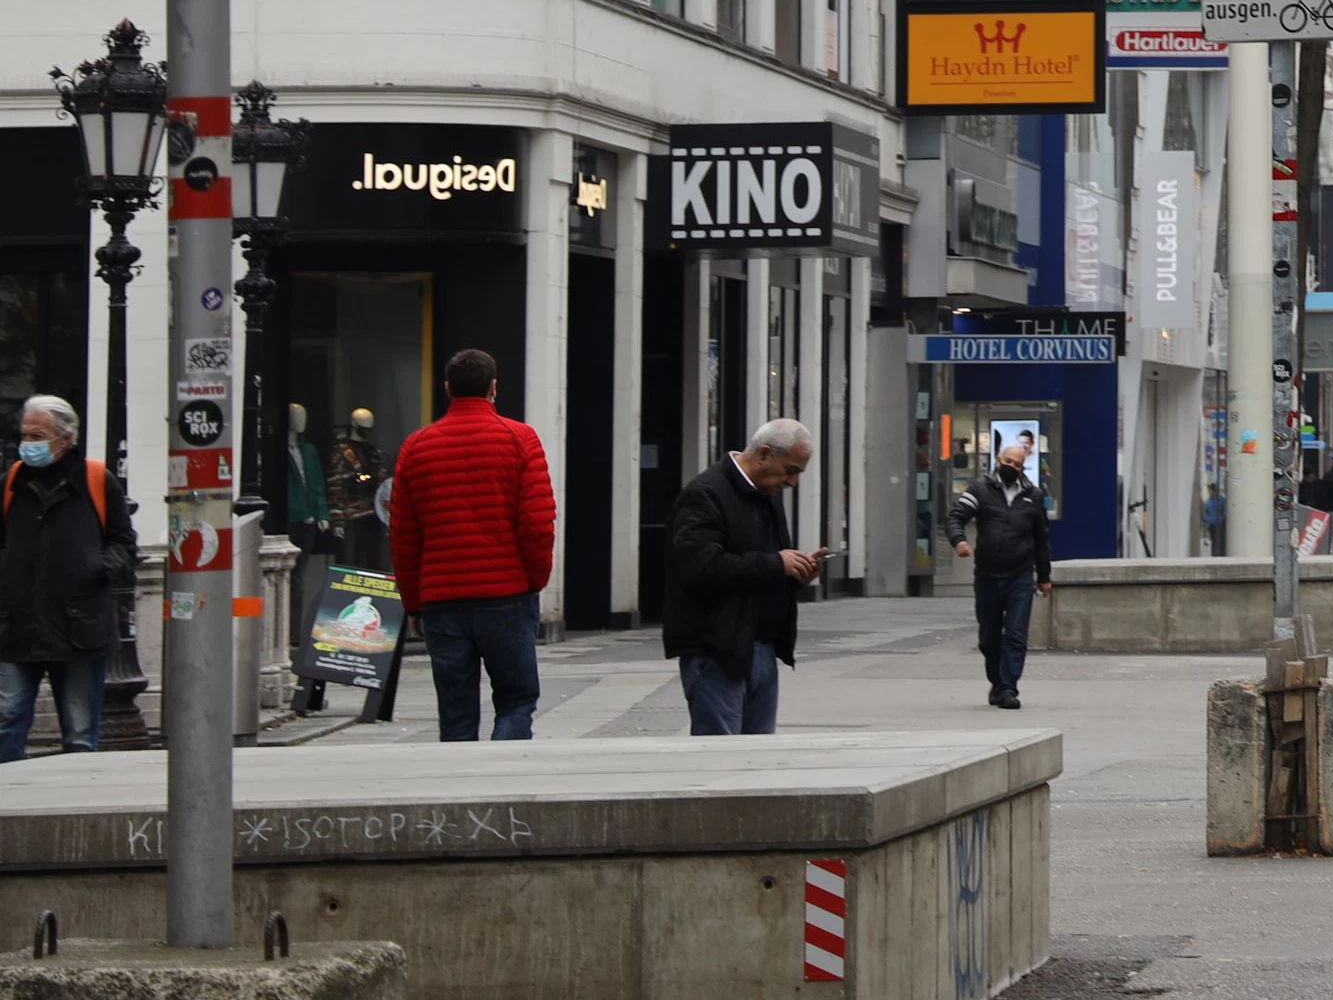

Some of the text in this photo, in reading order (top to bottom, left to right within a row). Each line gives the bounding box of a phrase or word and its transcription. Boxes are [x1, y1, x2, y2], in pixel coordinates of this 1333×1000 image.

[1205, 2, 1278, 23] ausgen.
[930, 56, 1006, 82] Haydn
[671, 158, 822, 226] KINO
[1156, 179, 1178, 302] PULL&BEAR
[950, 338, 1108, 360] HOTEL CORVINUS
